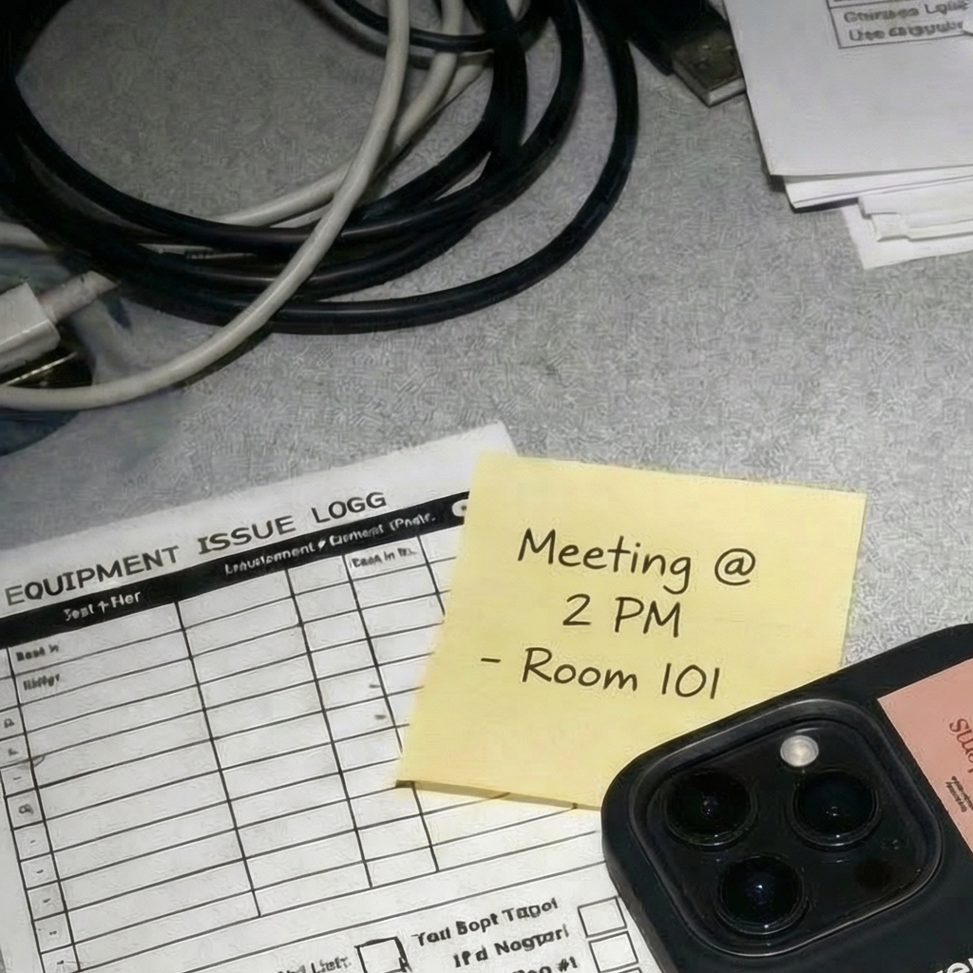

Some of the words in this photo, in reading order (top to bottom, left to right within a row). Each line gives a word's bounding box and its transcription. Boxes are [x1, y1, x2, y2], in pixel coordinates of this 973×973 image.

[4, 545, 179, 606] EQUIPMENT
[197, 515, 296, 555] ISSUE
[311, 491, 387, 524] LOGG
[517, 527, 691, 595] Meeting
[714, 547, 756, 586] @
[562, 593, 592, 626] 2
[614, 596, 681, 638] PM
[522, 647, 638, 692] Room
[662, 662, 720, 700] 101
[556, 956, 579, 973] #1
